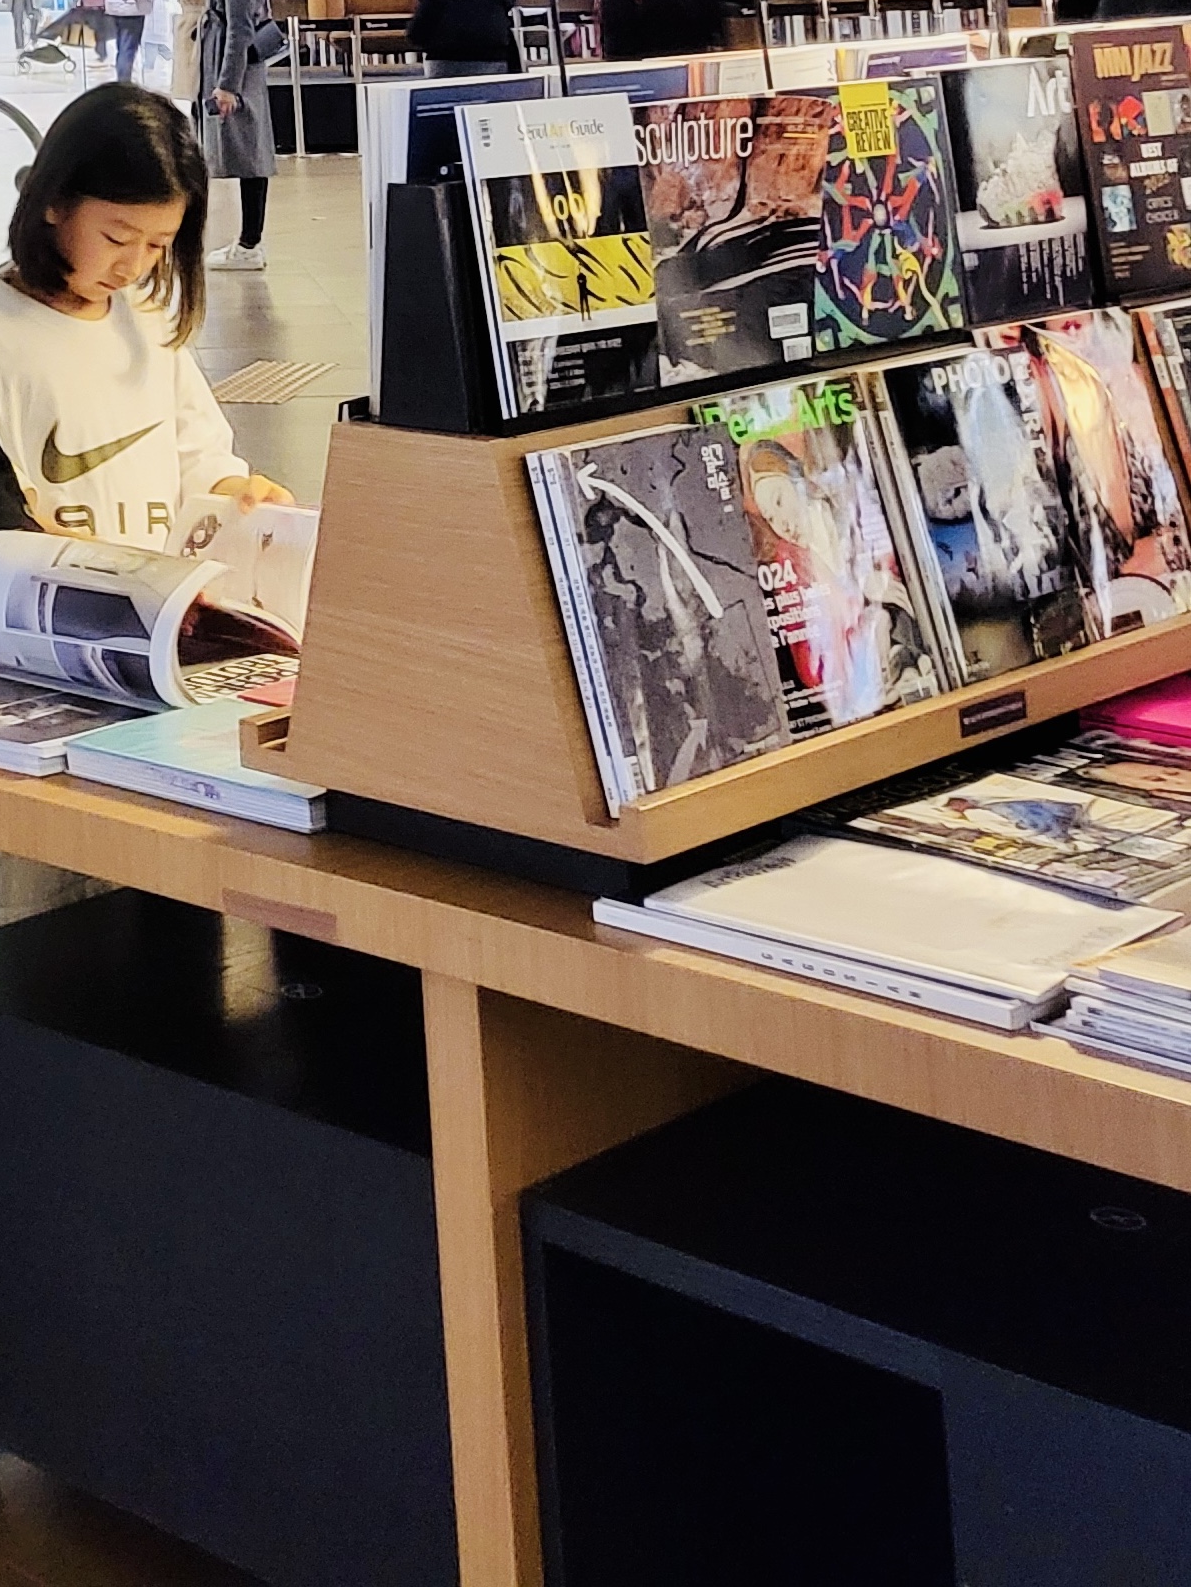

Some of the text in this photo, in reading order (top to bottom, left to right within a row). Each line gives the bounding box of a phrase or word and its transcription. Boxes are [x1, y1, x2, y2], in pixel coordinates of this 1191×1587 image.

[1027, 65, 1073, 118] Art
[570, 118, 605, 138] Guide
[845, 107, 890, 132] CREATIVE
[634, 112, 754, 168] sculpture
[855, 128, 893, 154] REVIEW
[797, 382, 857, 429] Arts
[54, 501, 171, 537] AIR
